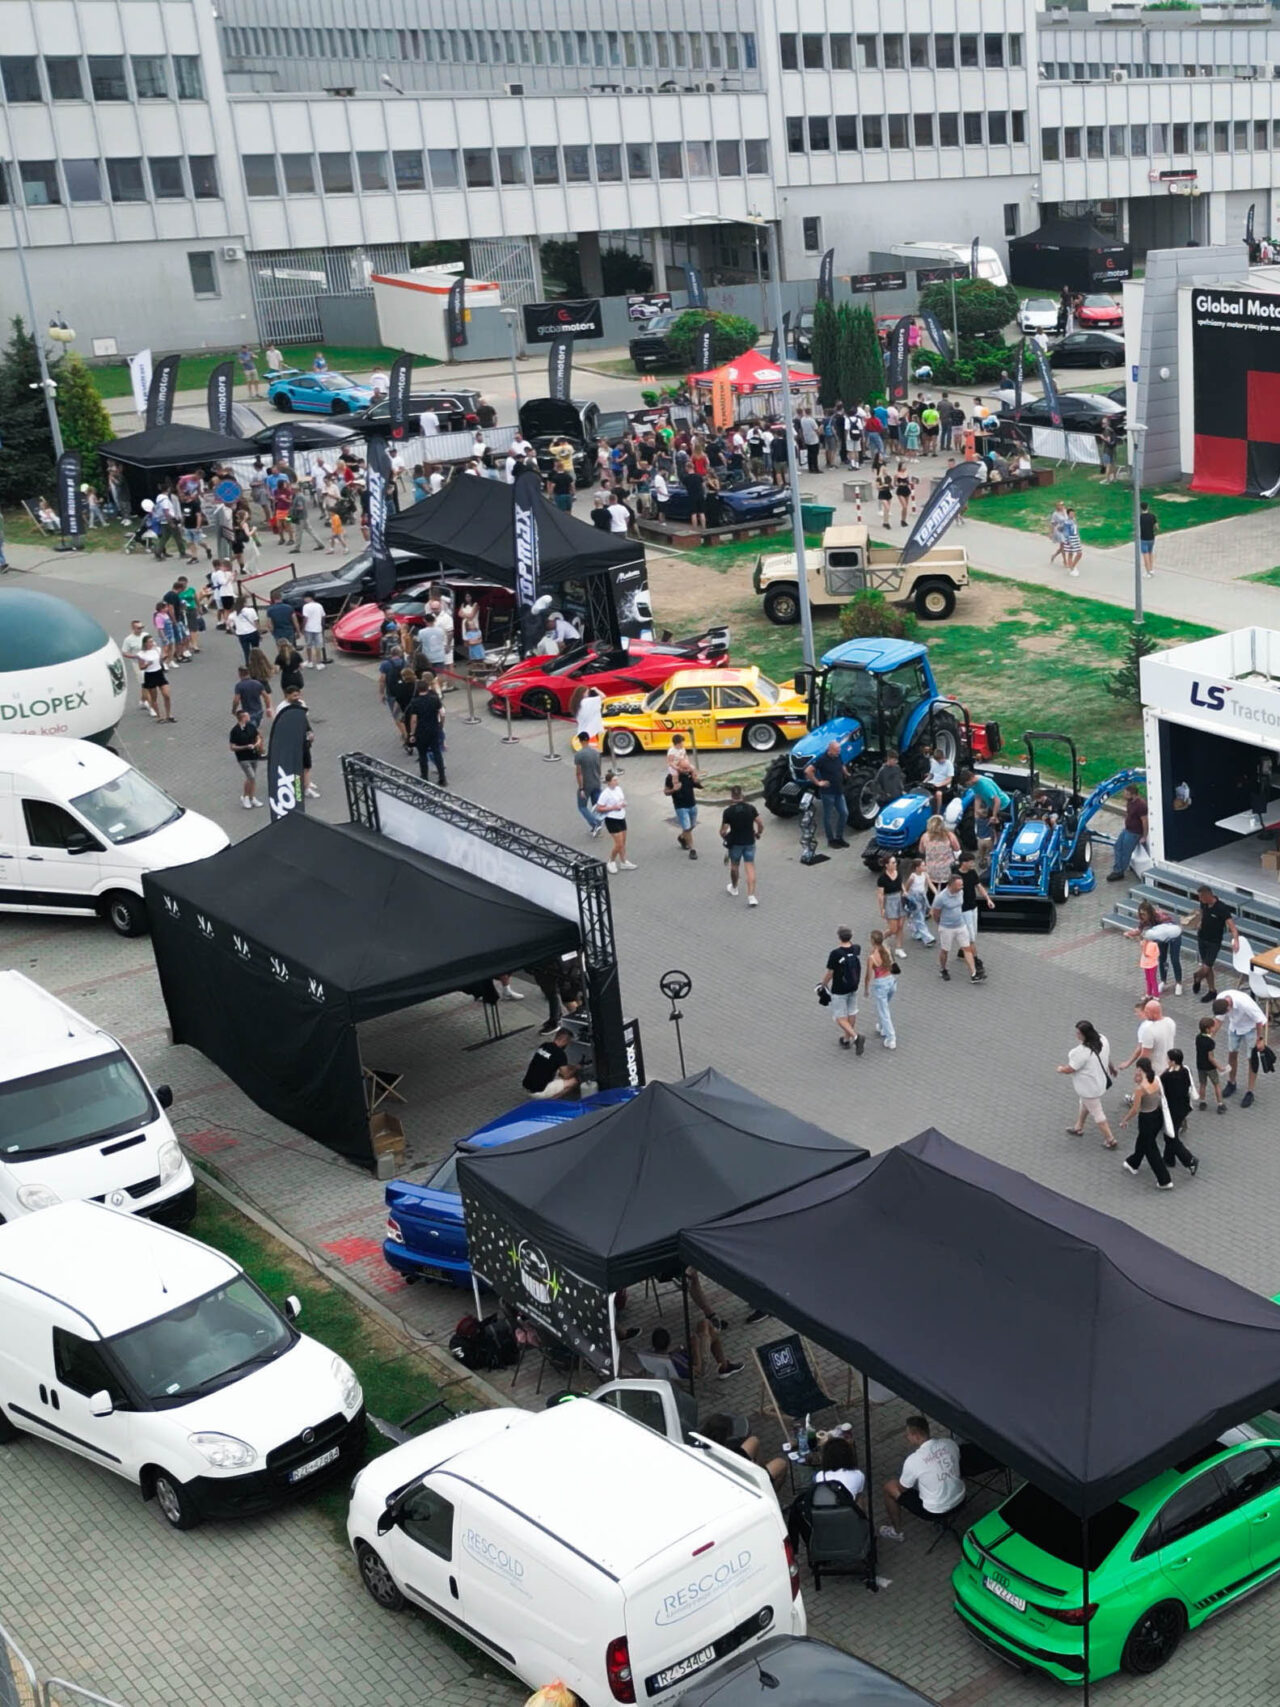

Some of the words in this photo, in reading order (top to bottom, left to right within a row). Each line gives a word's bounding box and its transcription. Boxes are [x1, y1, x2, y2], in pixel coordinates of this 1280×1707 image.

[1196, 295, 1243, 315] Global
[537, 322, 596, 337] globalmotors
[1190, 681, 1225, 711] LS
[466, 1528, 525, 1578] RESCOLD
[663, 1549, 752, 1614] RESCOLD
[658, 1668, 676, 1687] RZ
[678, 1647, 715, 1679] 544CU
